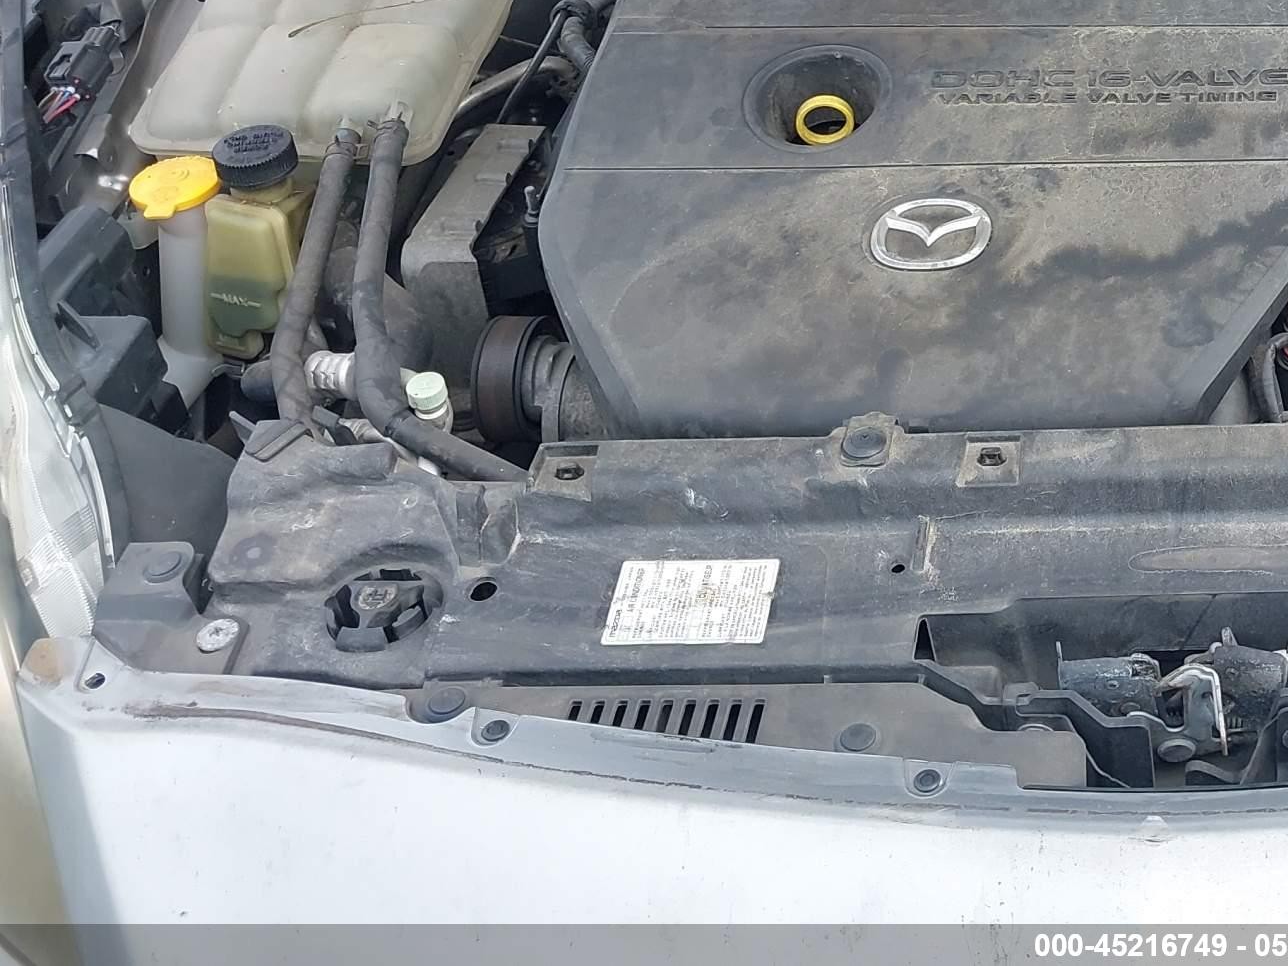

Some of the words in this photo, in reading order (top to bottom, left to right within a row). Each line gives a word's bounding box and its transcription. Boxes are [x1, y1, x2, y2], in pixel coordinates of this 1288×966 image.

[930, 70, 1076, 88] DOHC
[938, 91, 1077, 106] VARIABLE
[1087, 91, 1172, 105] VALVE
[1179, 90, 1277, 104] TIMING
[222, 293, 248, 307] MAX
